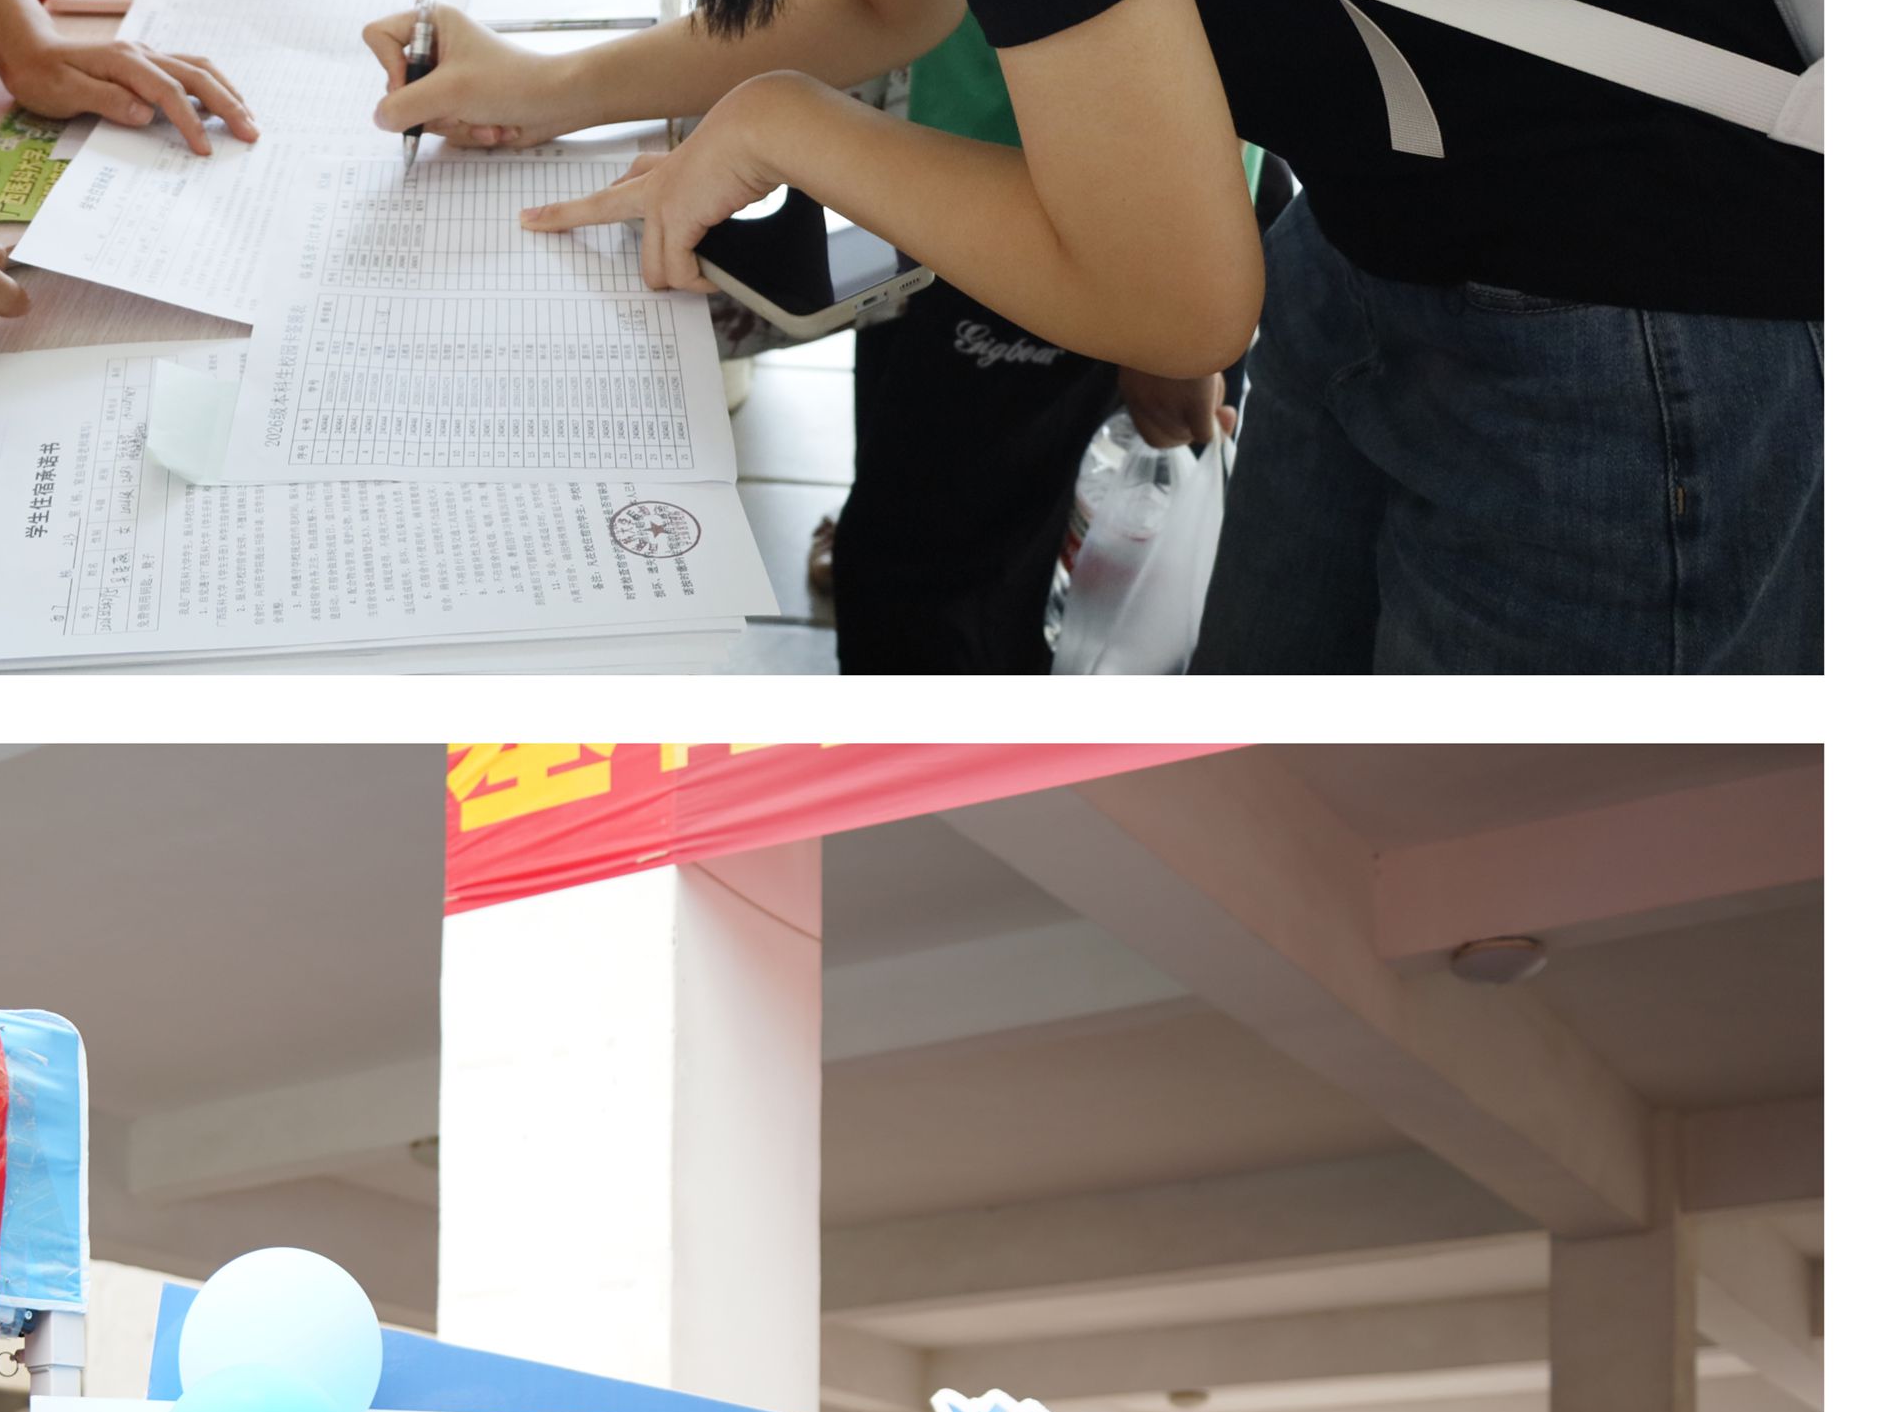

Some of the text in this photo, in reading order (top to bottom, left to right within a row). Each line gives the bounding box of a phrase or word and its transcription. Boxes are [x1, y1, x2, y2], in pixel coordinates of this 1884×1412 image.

[25, 442, 61, 539] 学生住宿承诺书
